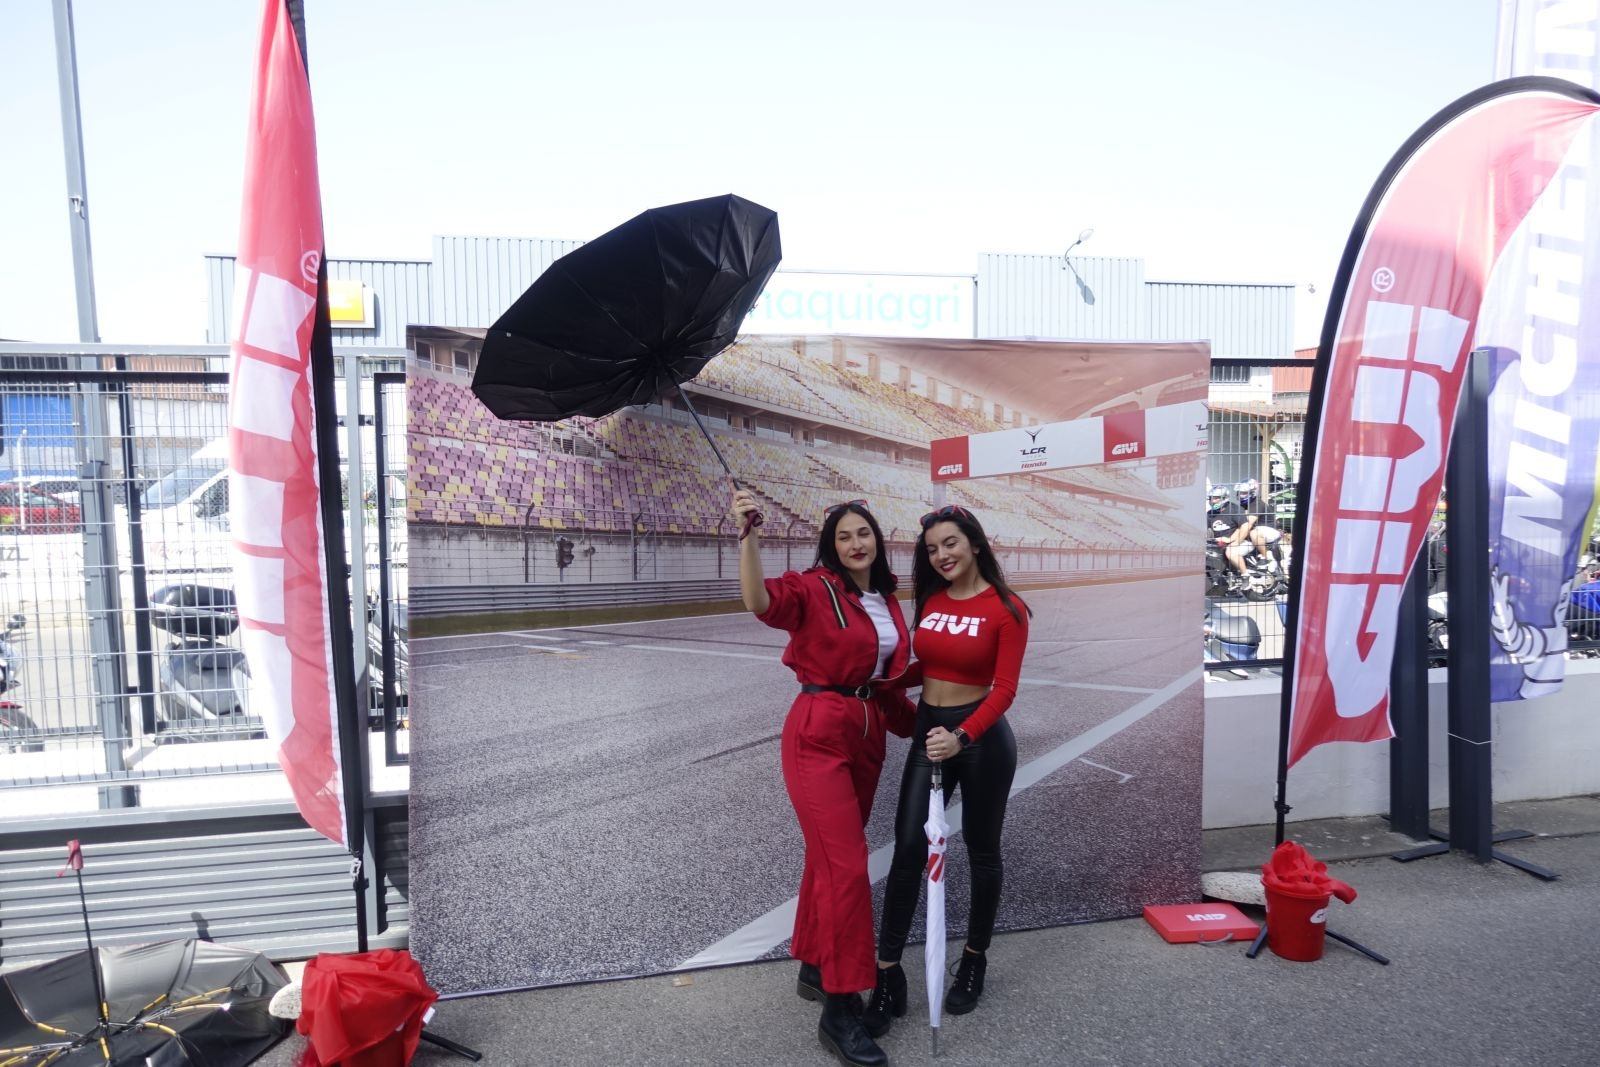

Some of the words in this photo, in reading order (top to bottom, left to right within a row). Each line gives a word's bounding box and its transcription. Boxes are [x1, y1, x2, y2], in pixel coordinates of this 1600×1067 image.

[1111, 442, 1138, 455] GIVI
[937, 464, 962, 476] GIVI
[920, 612, 980, 637] GIVI
